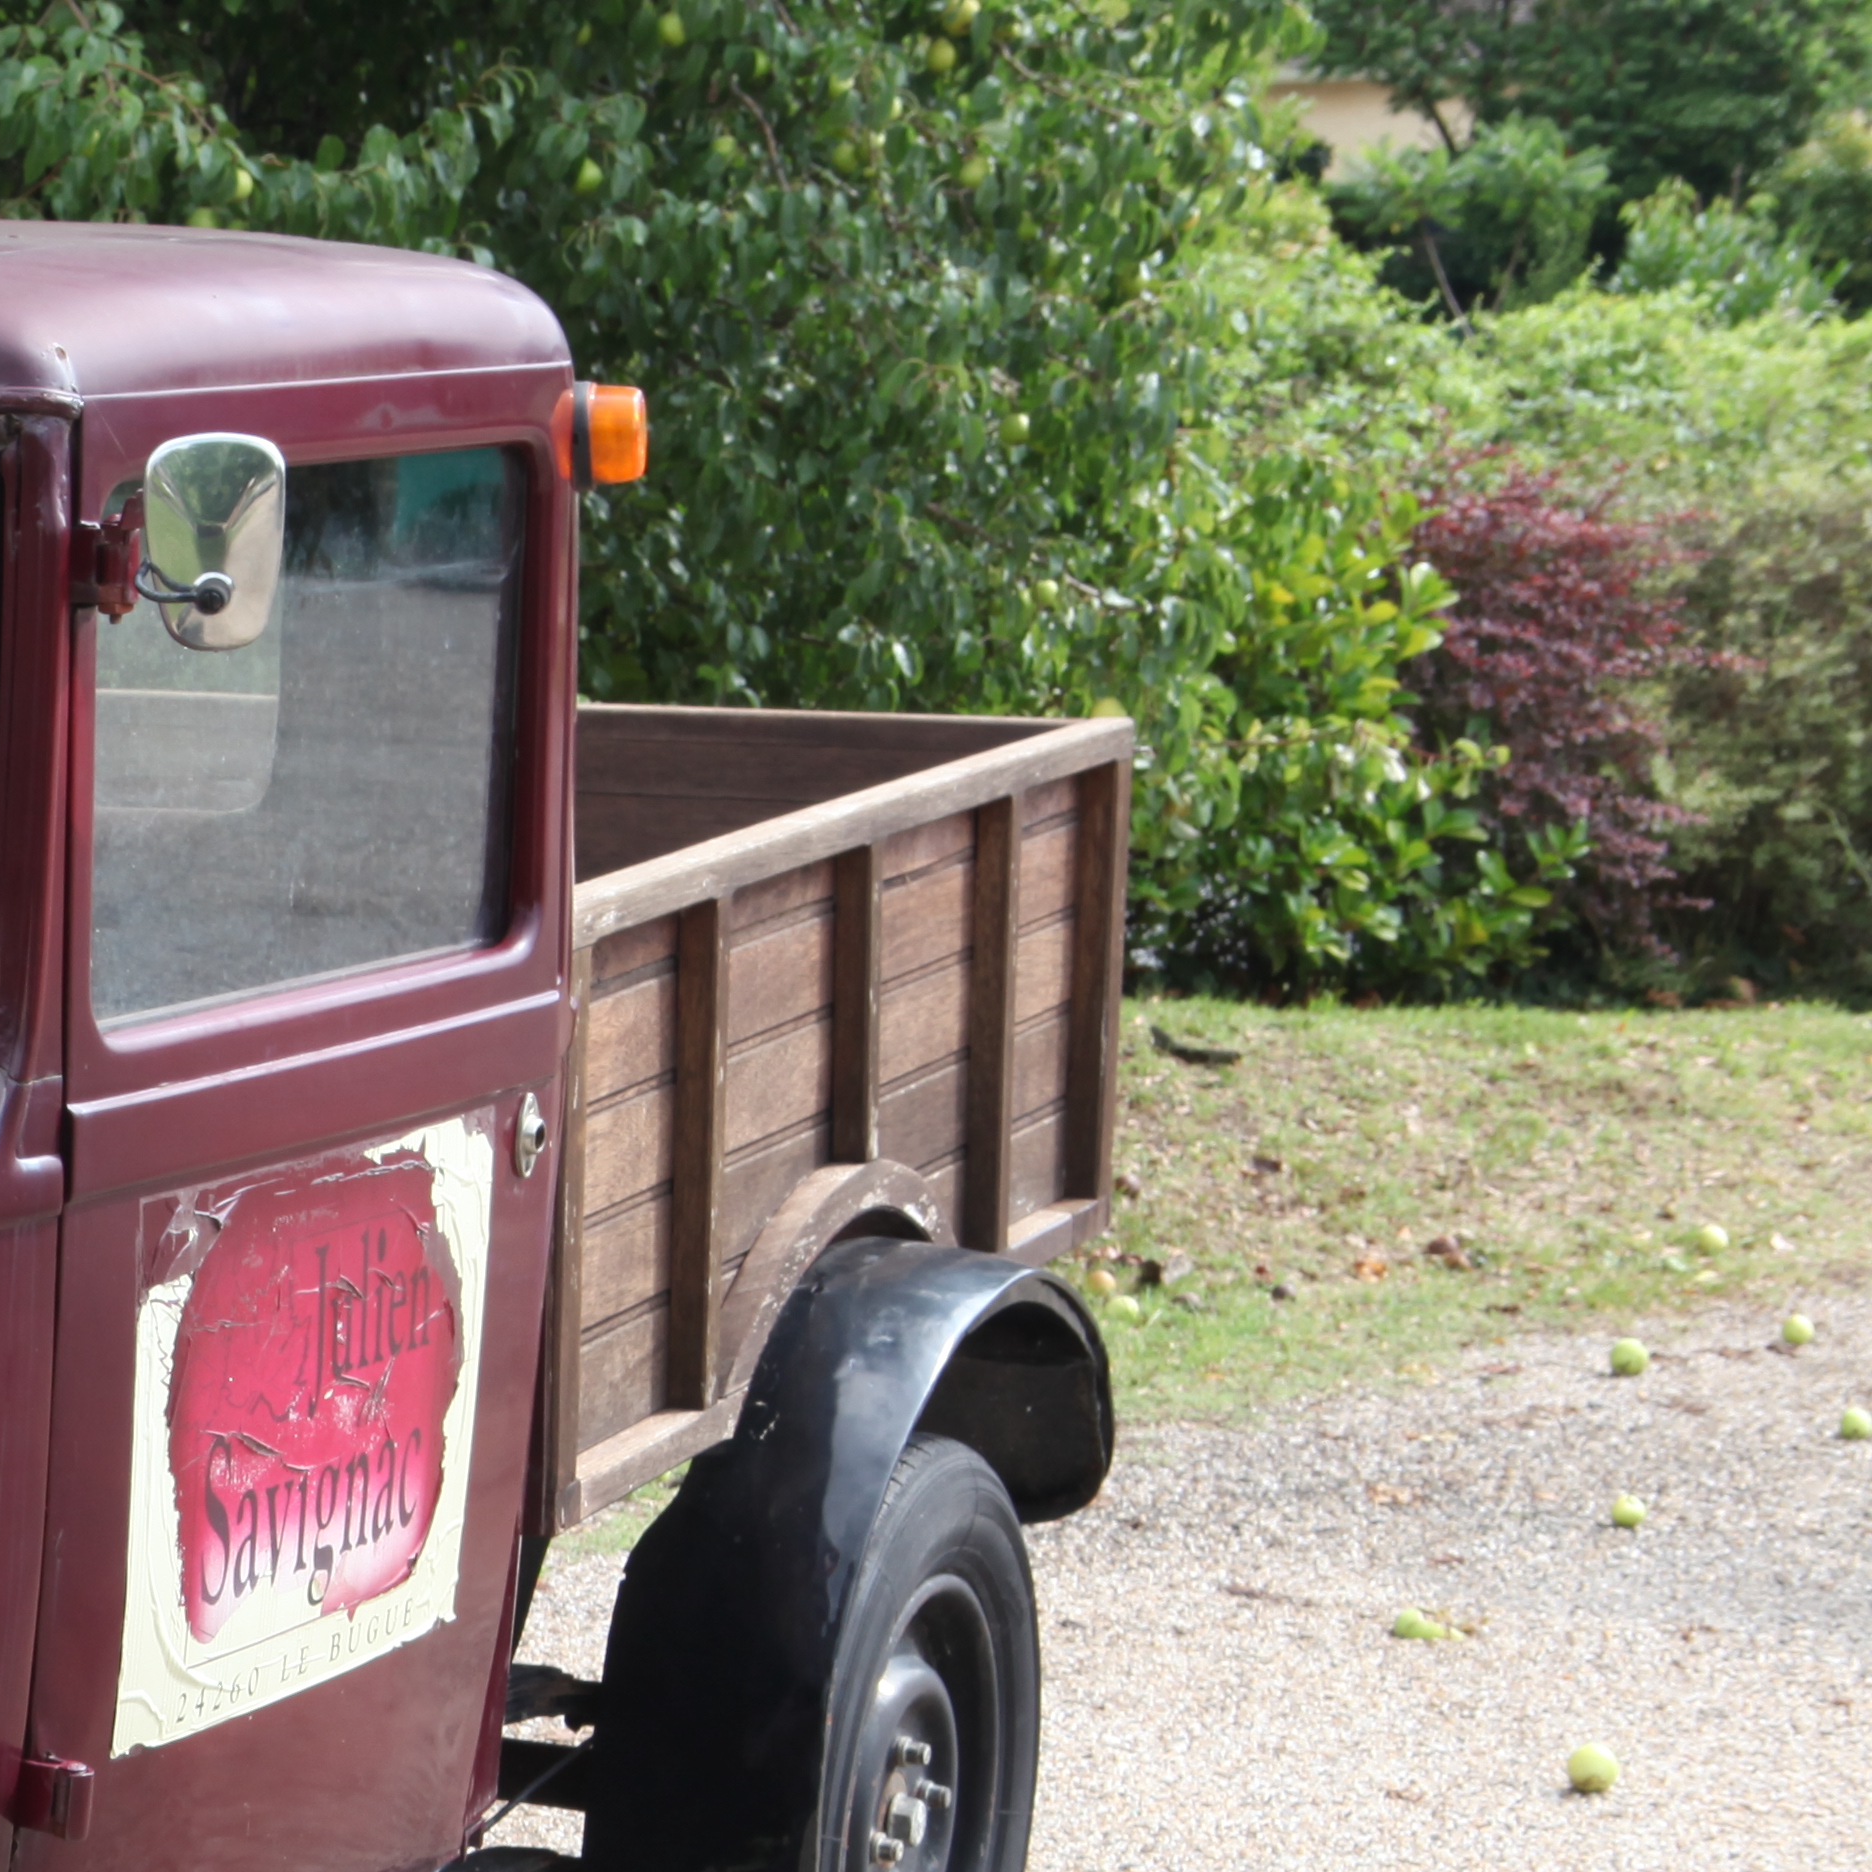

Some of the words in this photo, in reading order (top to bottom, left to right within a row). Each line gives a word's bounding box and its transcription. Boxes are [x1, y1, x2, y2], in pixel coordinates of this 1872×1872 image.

[307, 1226, 430, 1420] Julien
[201, 1428, 421, 1606] Savignac
[175, 1667, 260, 1724] 24260
[279, 1646, 310, 1684] LE
[329, 1597, 414, 1663] BUGUE
